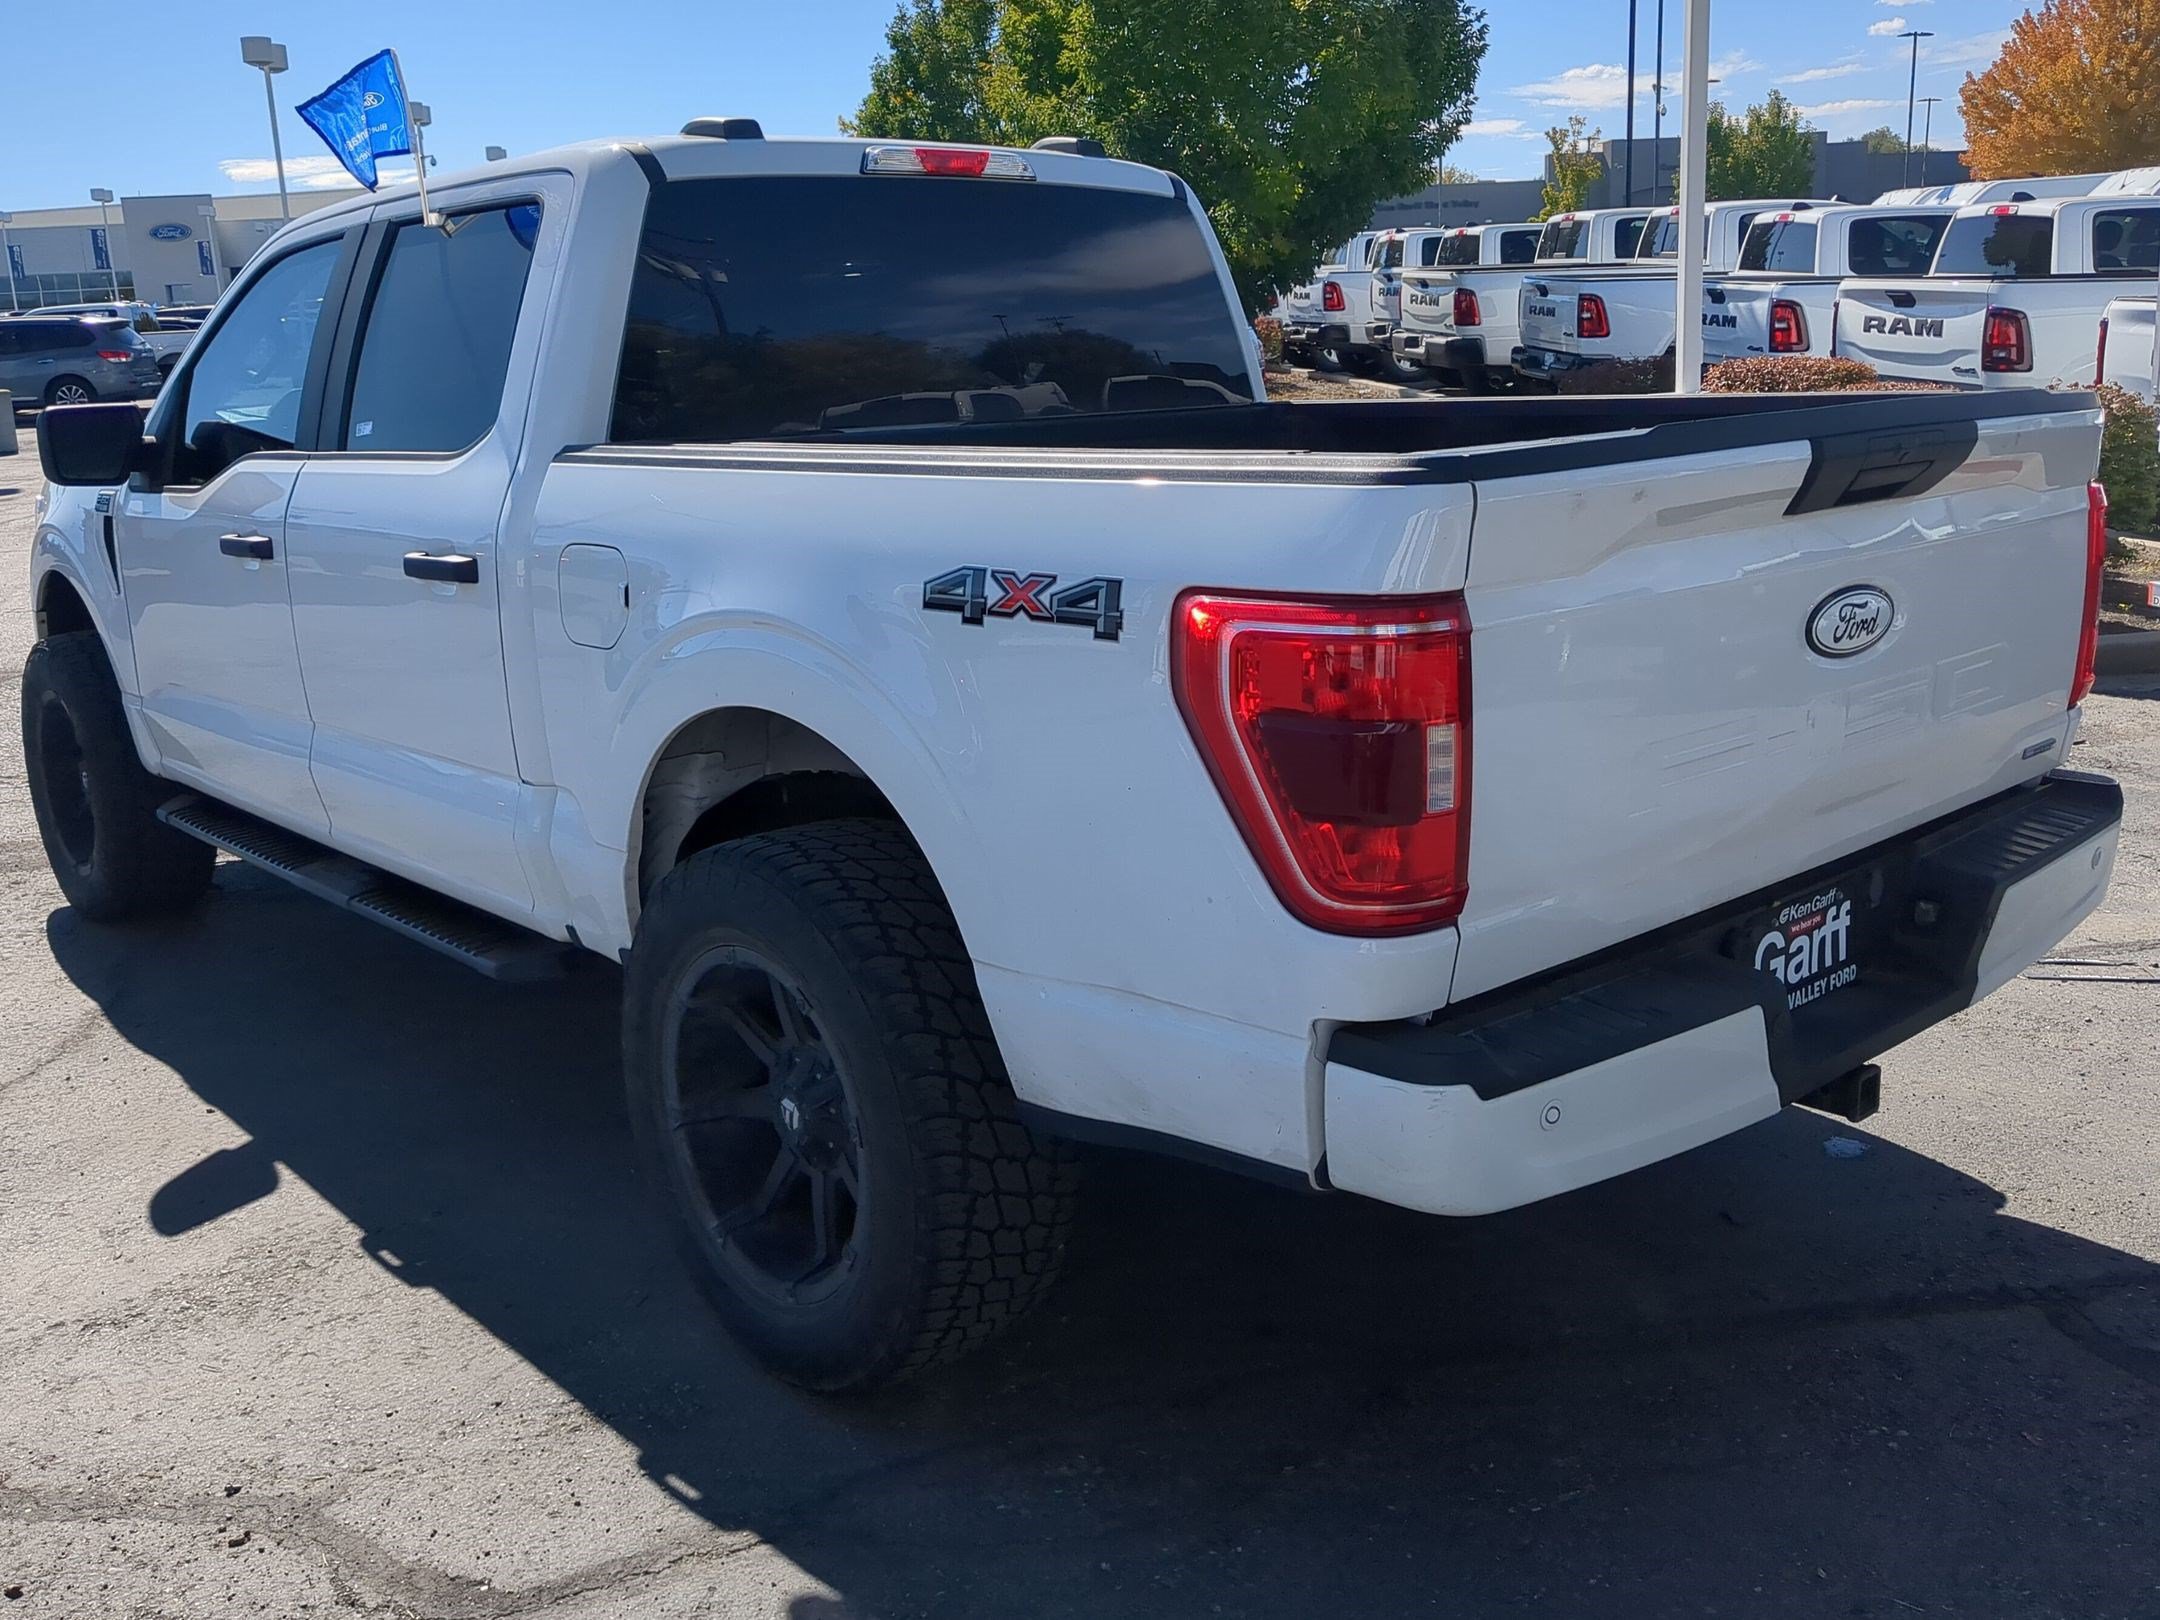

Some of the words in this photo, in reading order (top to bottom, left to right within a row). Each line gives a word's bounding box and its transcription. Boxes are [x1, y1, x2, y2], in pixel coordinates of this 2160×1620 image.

[1293, 291, 1311, 300] RAM
[1410, 294, 1440, 307] RAM
[1529, 305, 1556, 318] RAM
[1863, 315, 1945, 338] RAM
[1833, 600, 1880, 644] Ford
[1789, 901, 1811, 922] Ken
[1811, 887, 1837, 912] Garff
[1754, 899, 1852, 985] Garff
[1787, 977, 1828, 1010] VALLEY
[1829, 963, 1857, 991] FORD
